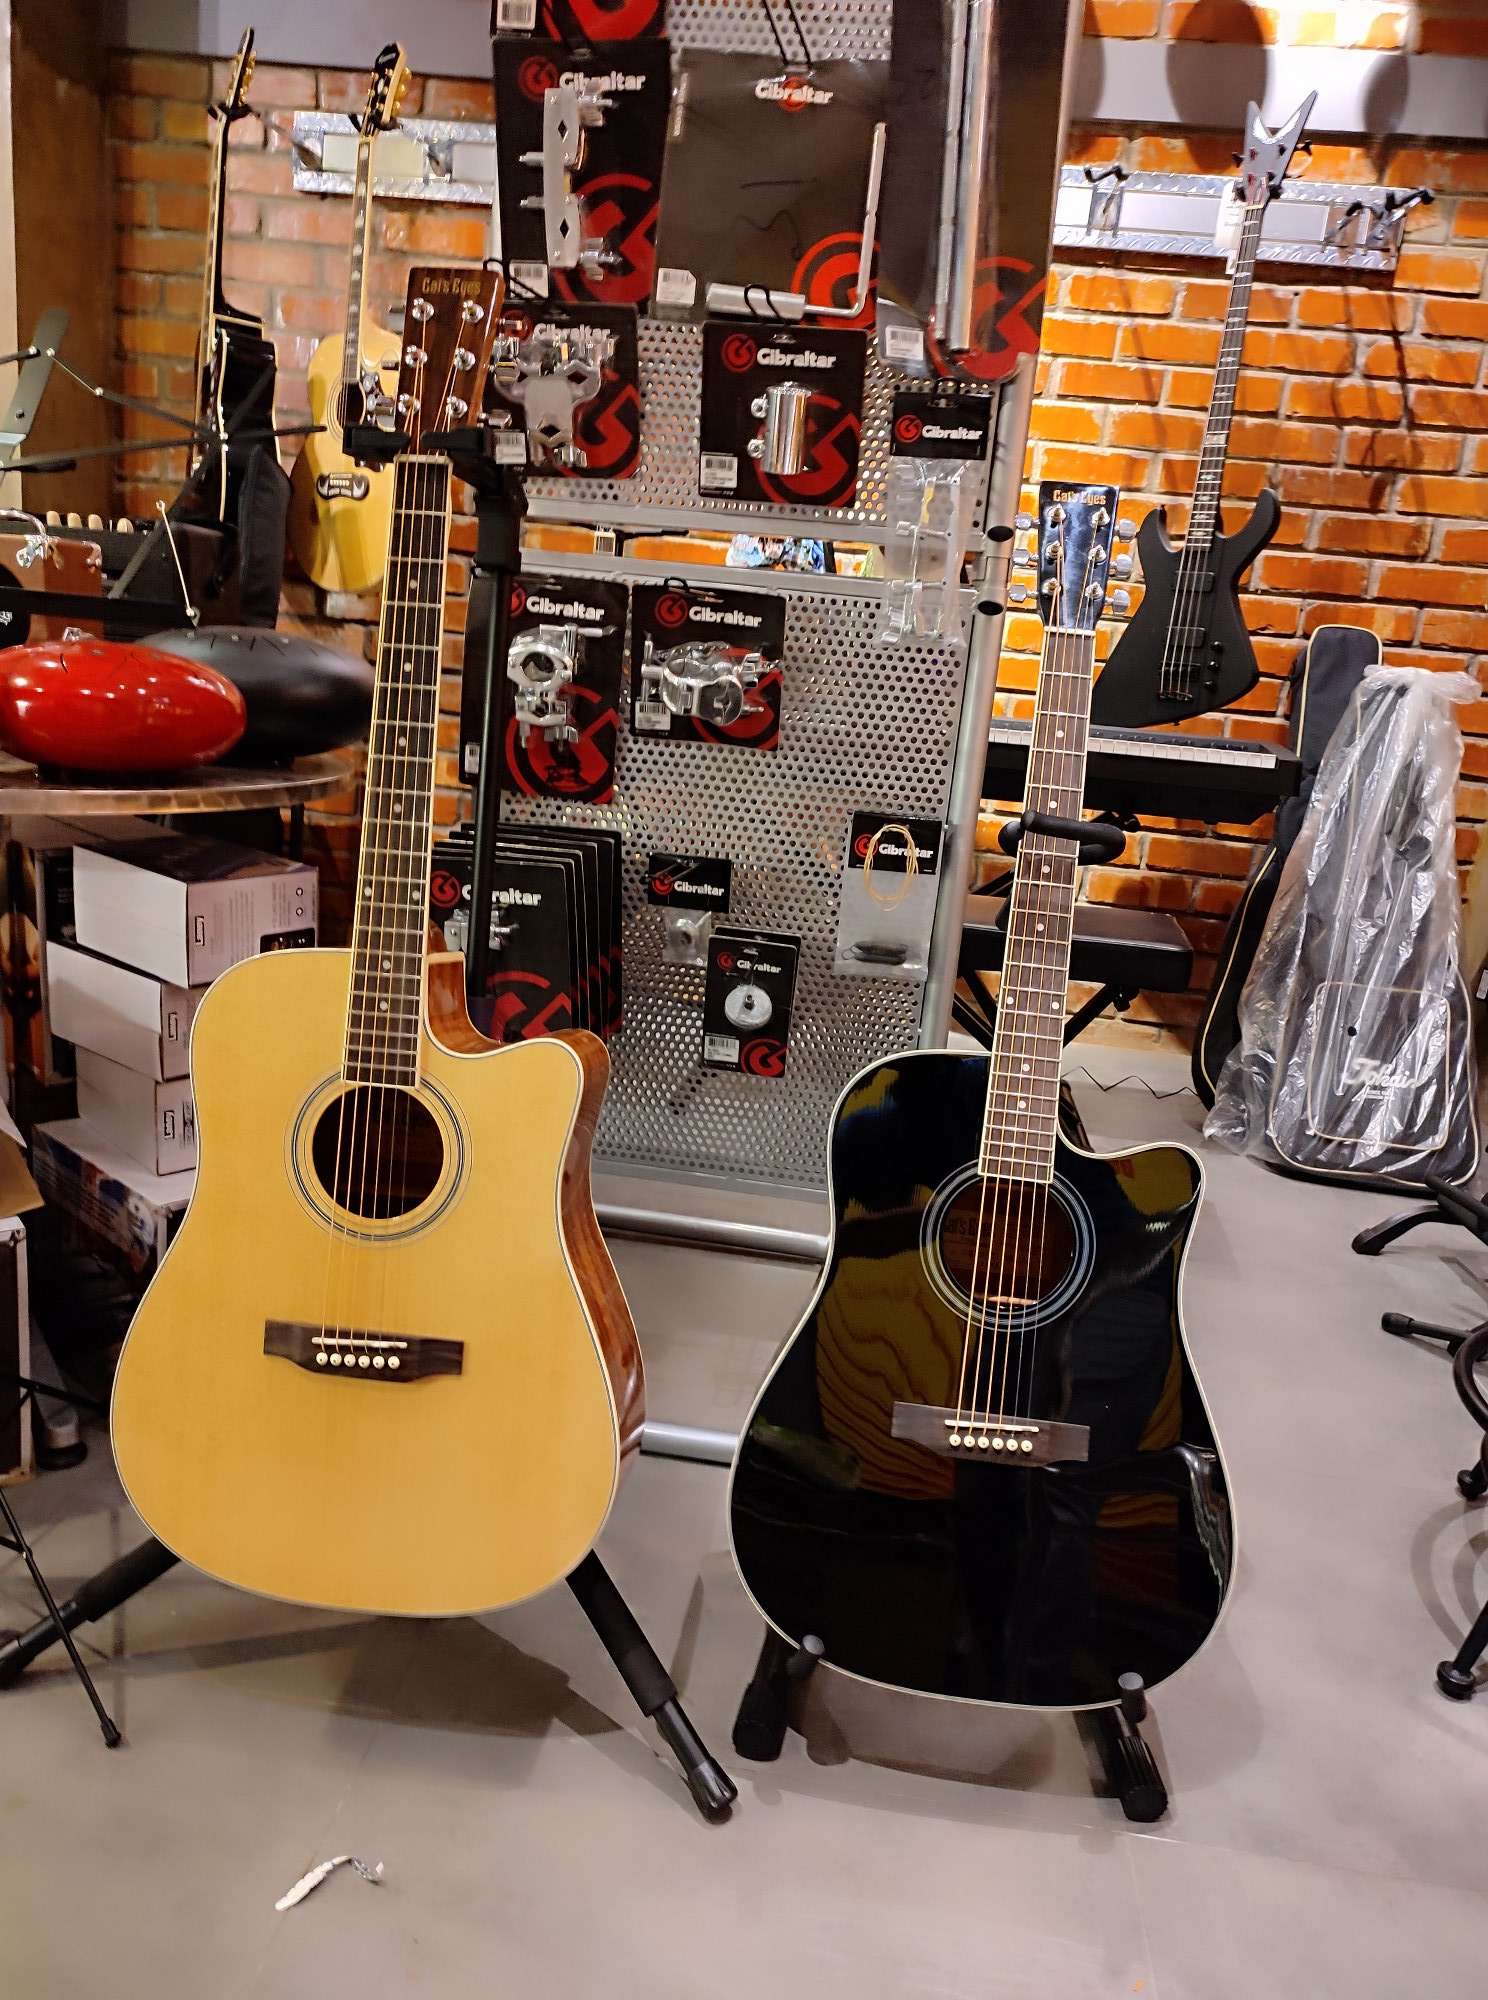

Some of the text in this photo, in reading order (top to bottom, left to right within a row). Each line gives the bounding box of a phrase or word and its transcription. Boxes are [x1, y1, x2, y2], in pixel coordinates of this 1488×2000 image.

[754, 78, 834, 104] Gibraltar
[756, 347, 837, 368] Gibraltar
[922, 425, 983, 440] Gibraltar
[526, 595, 605, 621] Gibraltar
[688, 605, 763, 627] Gibraltar
[878, 843, 934, 859] Gibratar
[462, 884, 541, 906] Graltar
[674, 880, 724, 897] Gibraltar
